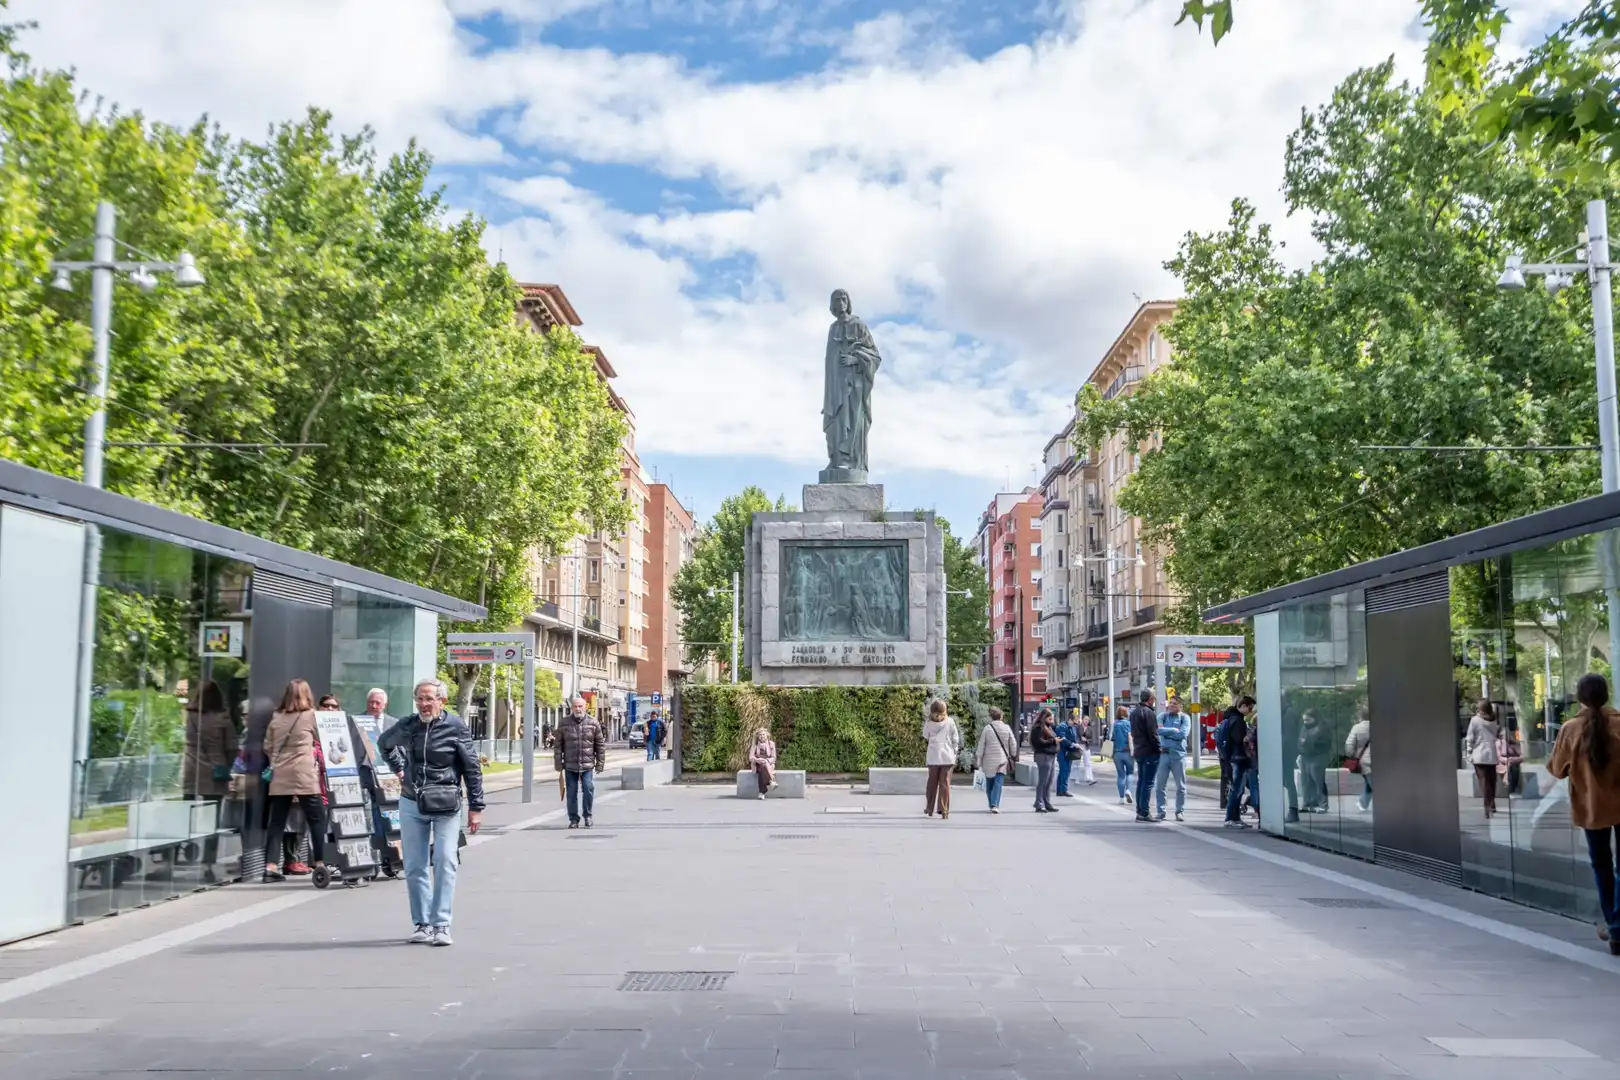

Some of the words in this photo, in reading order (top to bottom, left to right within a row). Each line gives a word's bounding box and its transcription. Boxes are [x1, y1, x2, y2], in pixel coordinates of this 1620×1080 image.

[831, 645, 837, 654] A
[843, 646, 853, 654] SU
[858, 646, 876, 654] GRAN
[841, 656, 850, 664] EL
[652, 696, 660, 704] P
